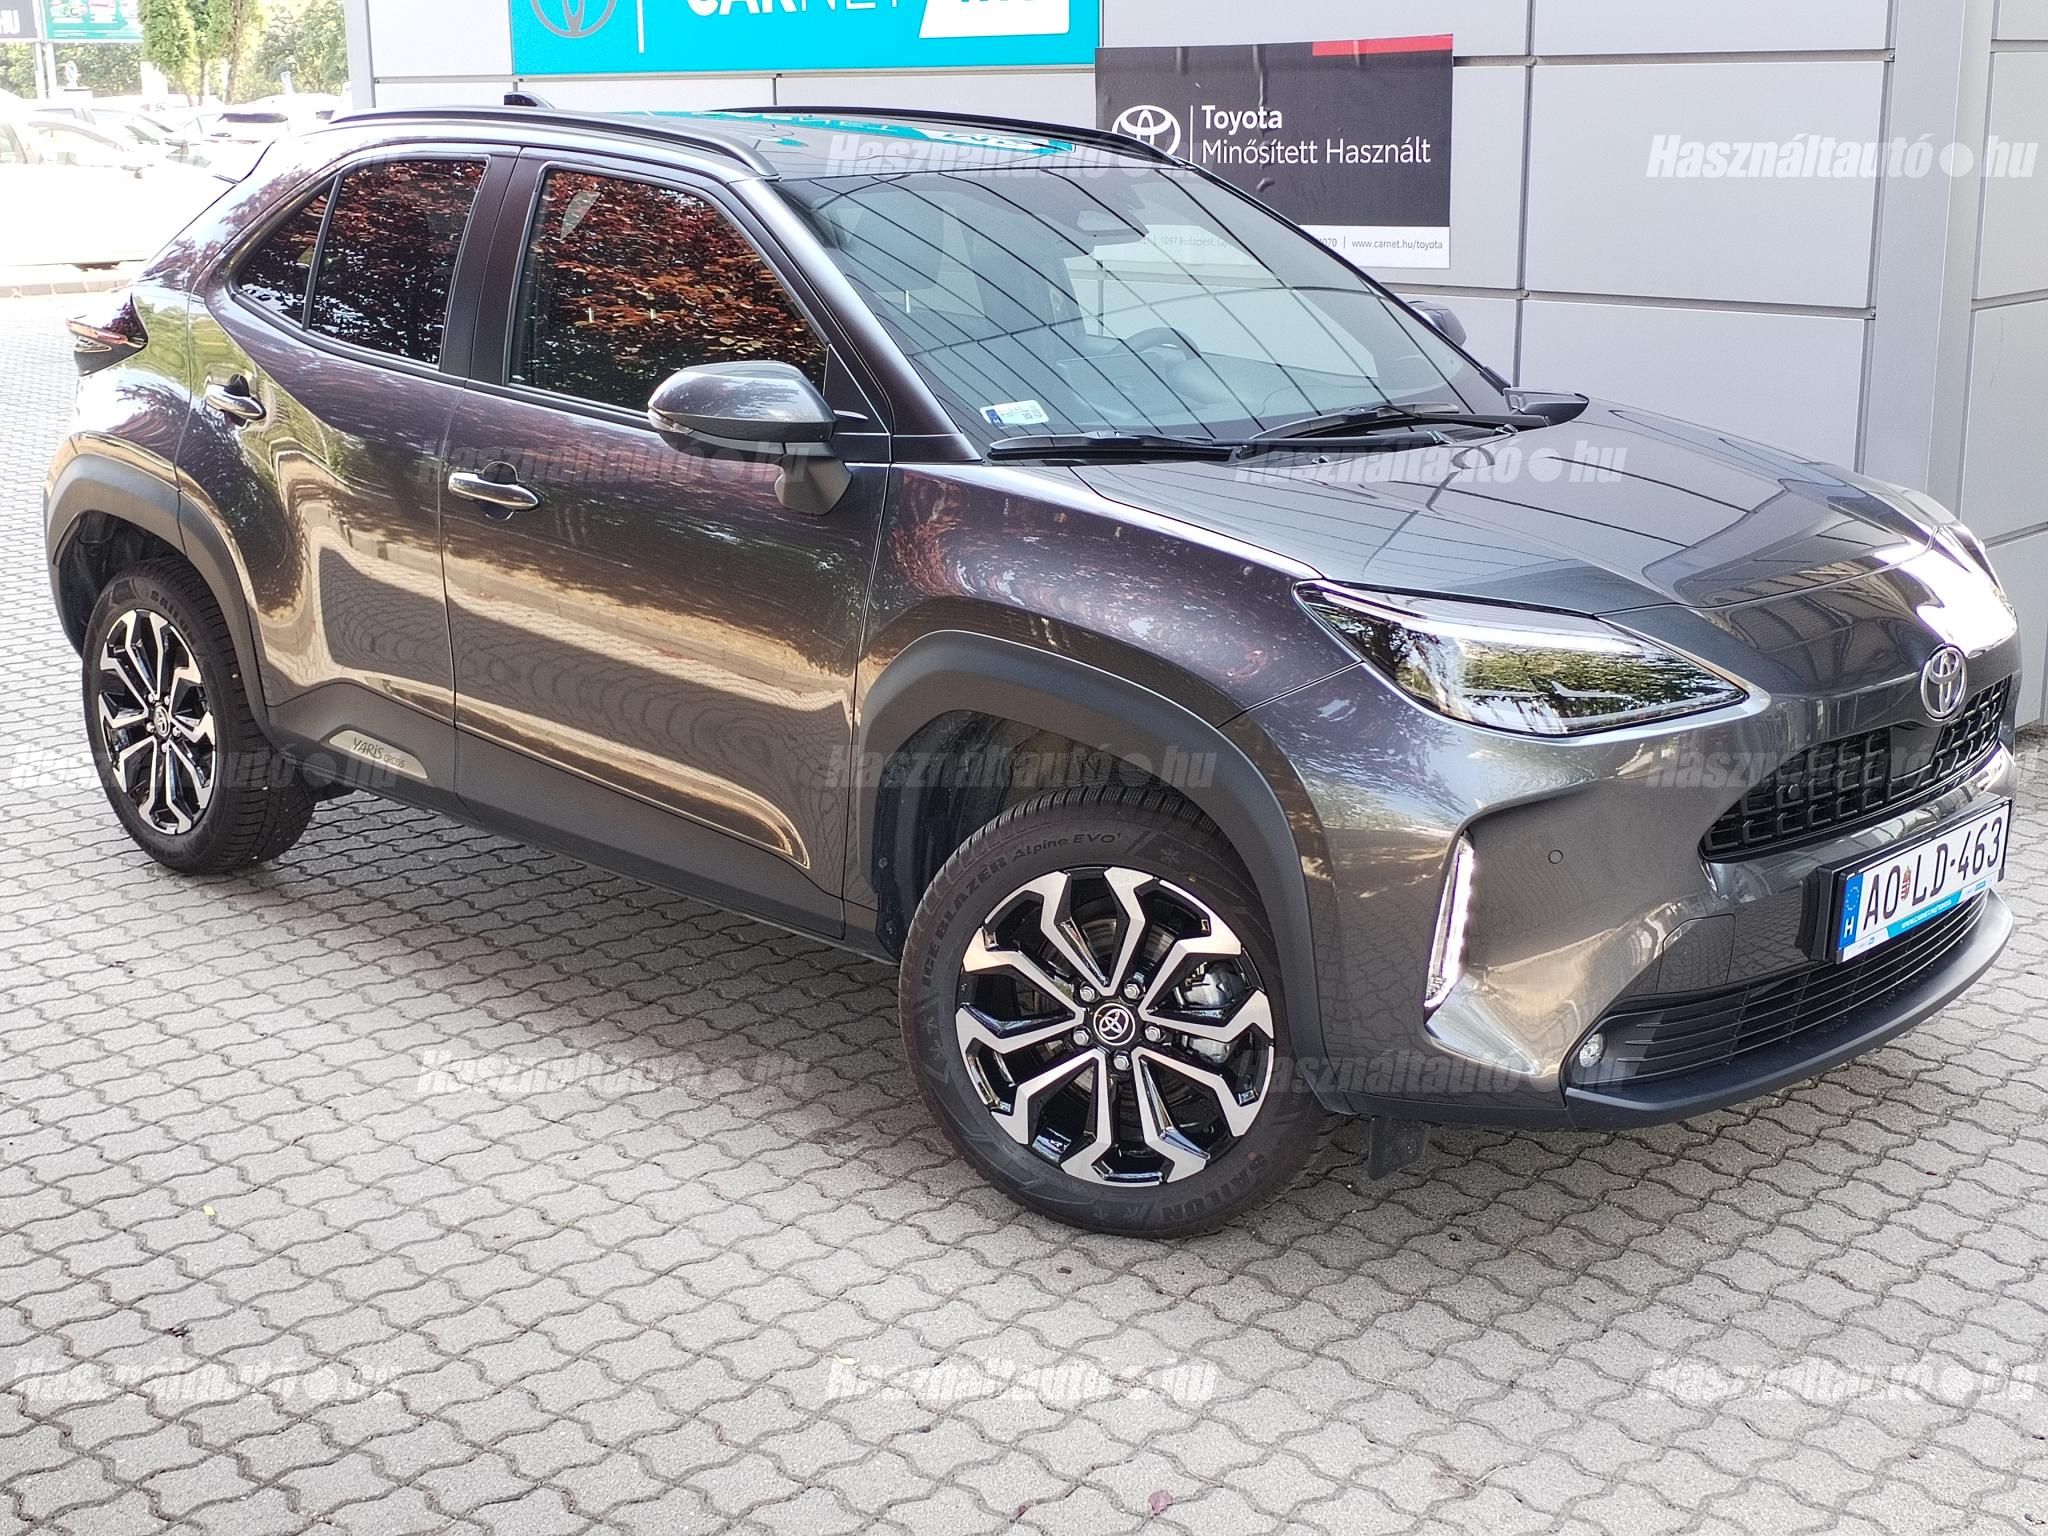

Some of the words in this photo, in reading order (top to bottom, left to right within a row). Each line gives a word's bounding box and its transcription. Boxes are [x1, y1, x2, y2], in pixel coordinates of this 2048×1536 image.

[1201, 105, 1282, 135] Toyota
[1202, 137, 1318, 164] Minősített
[1326, 135, 1431, 164] Használt
[1352, 239, 1443, 251] www.carnet.hu/toyota
[1013, 837, 1069, 862] Alpine
[1843, 915, 1855, 939] H
